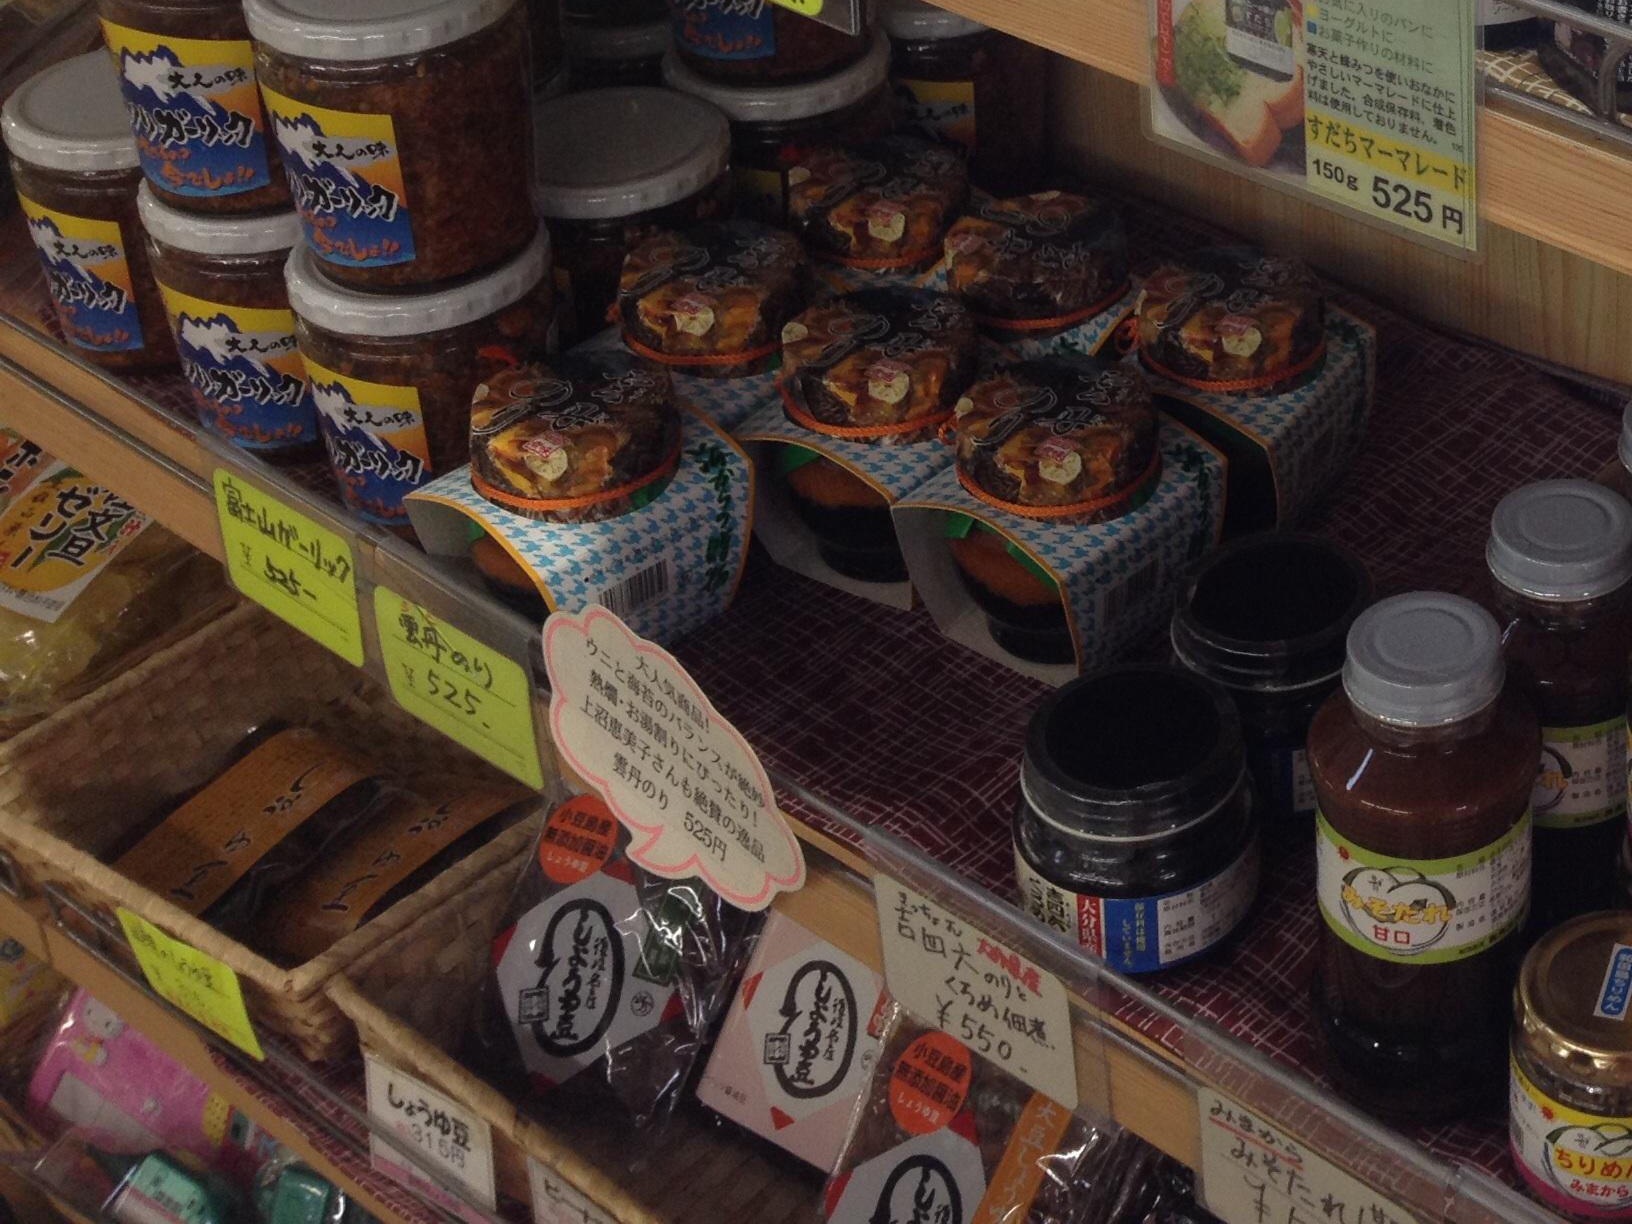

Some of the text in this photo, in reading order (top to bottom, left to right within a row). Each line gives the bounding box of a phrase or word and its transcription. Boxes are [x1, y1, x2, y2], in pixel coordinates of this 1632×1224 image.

[1319, 8, 1394, 44] ヨーグルトに
[1307, 114, 1468, 191] すだちマーマレード
[1311, 157, 1359, 192] 150g
[221, 477, 353, 584] 富士山ガーリック
[683, 810, 728, 862] 525円
[1342, 884, 1453, 925] みそだれ
[1373, 924, 1411, 945] 甘口
[386, 1081, 473, 1153] しょうゆ豆
[1569, 1178, 1630, 1199] みまから
